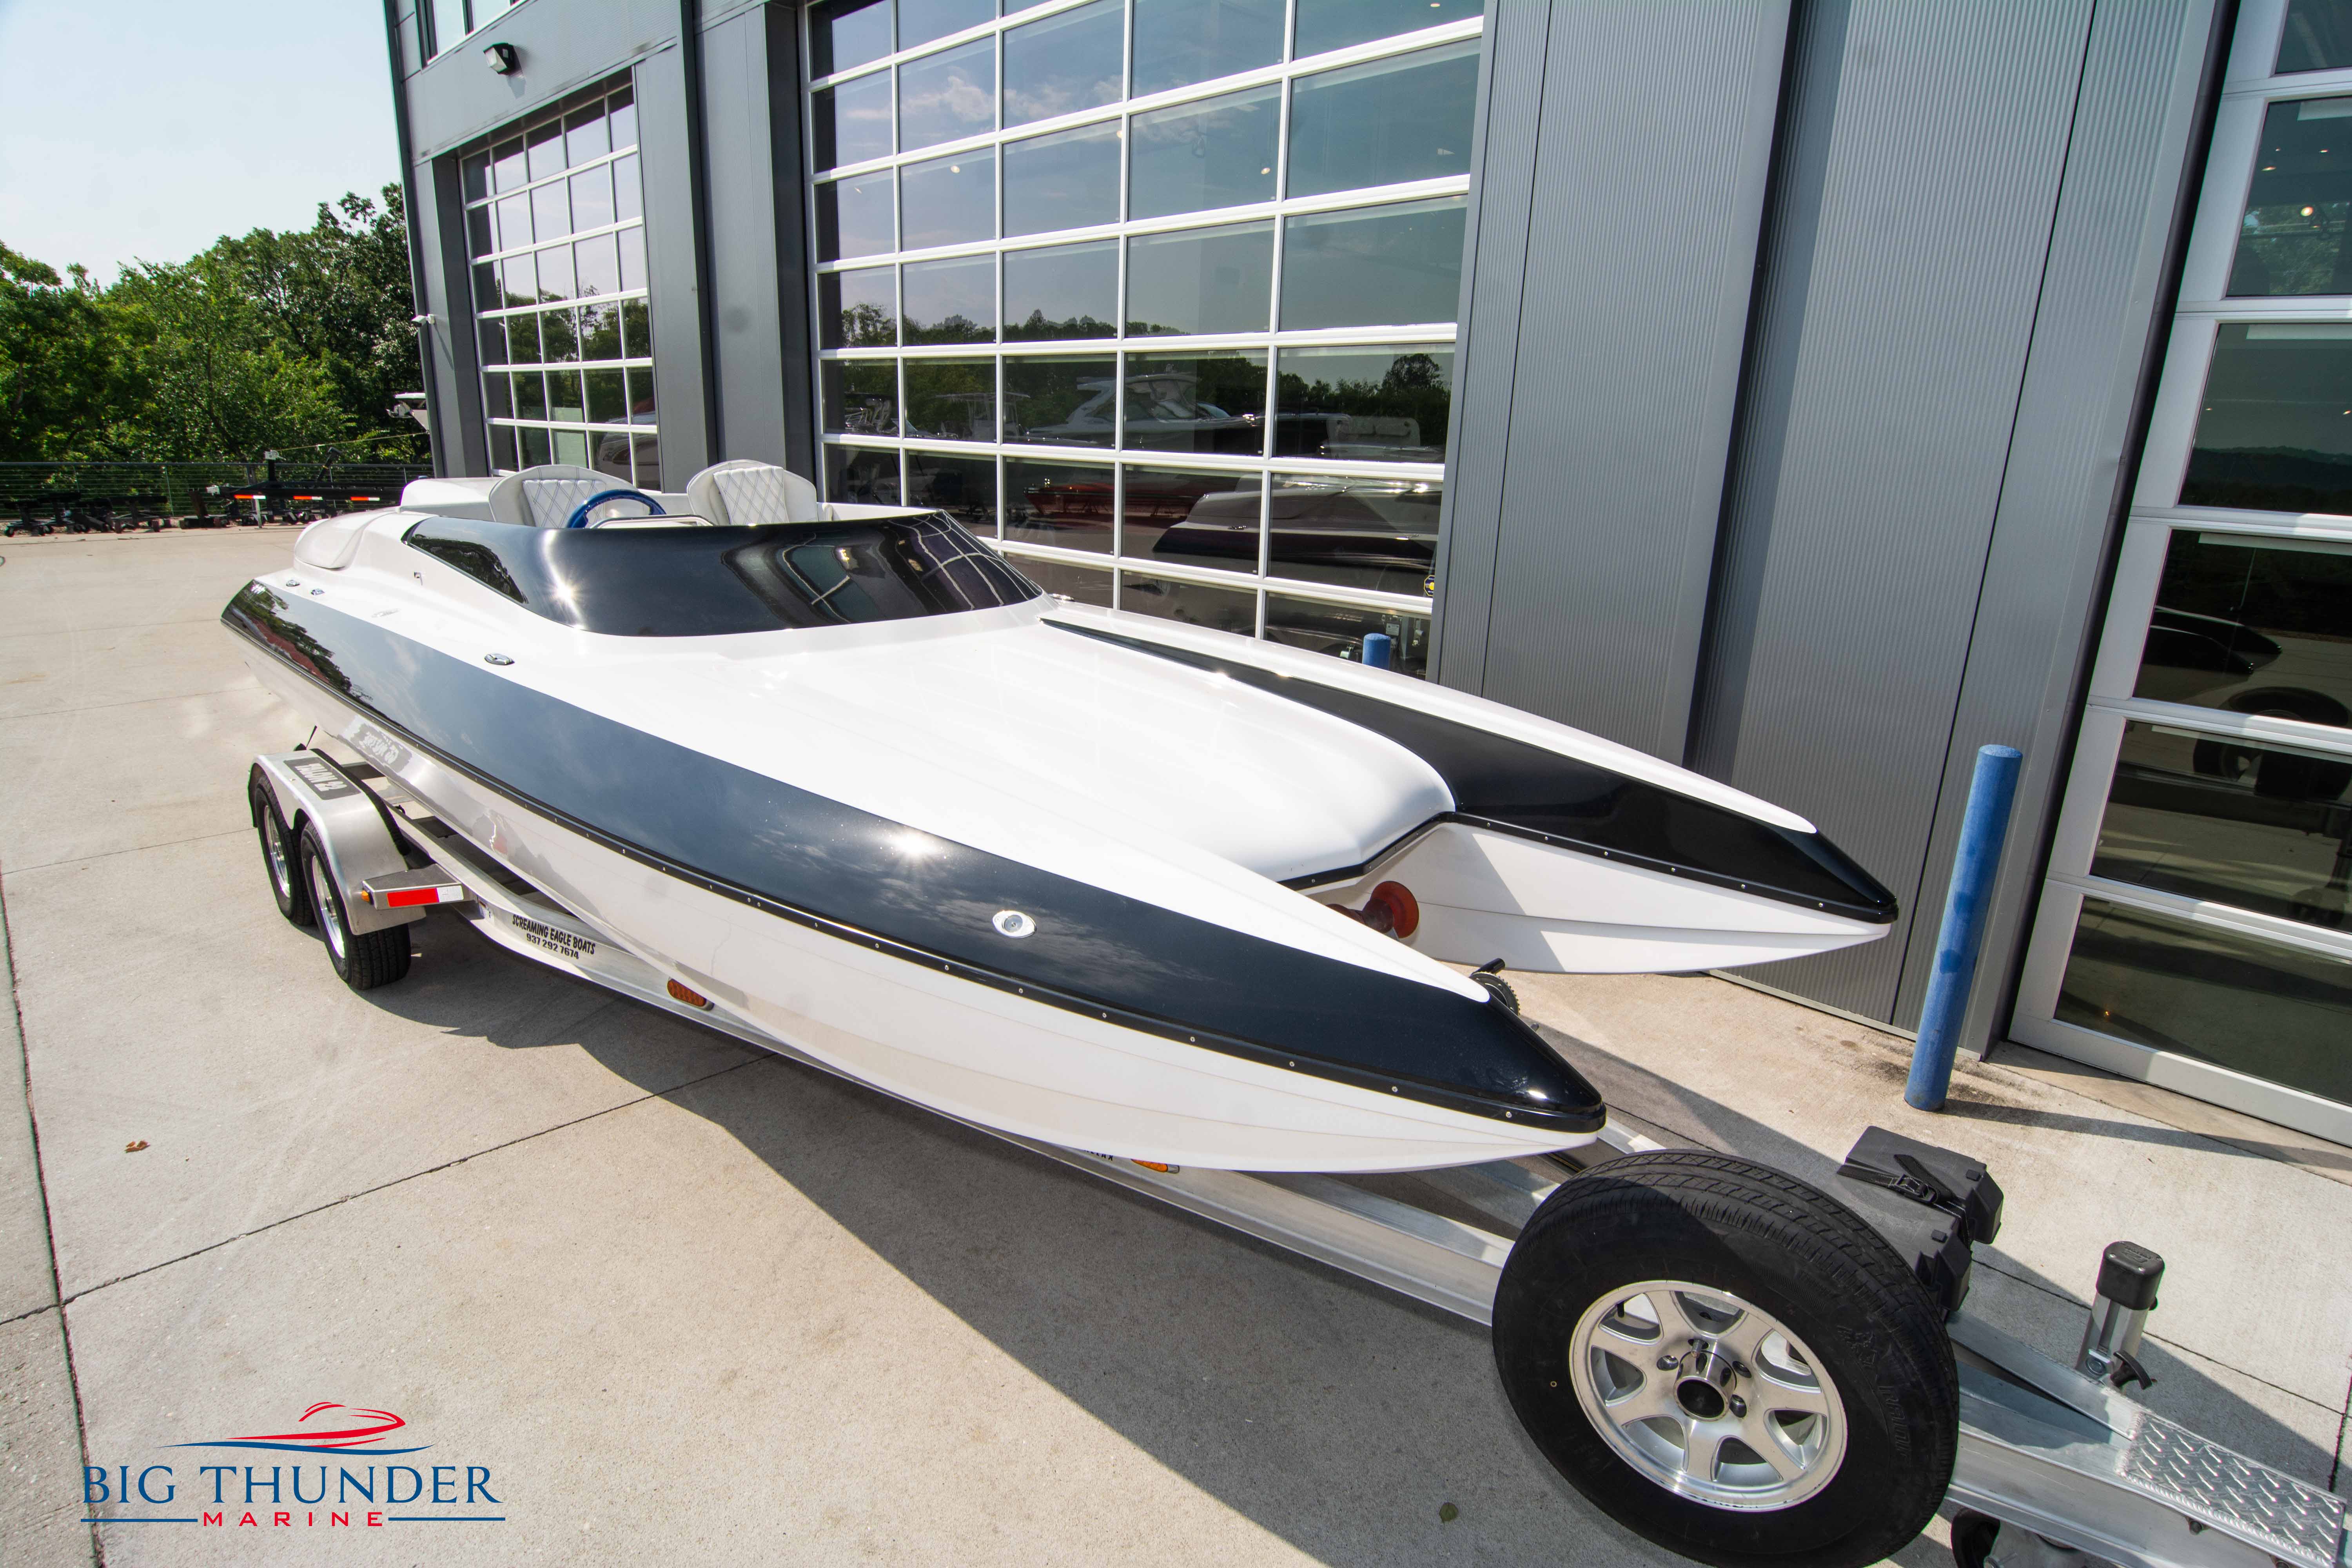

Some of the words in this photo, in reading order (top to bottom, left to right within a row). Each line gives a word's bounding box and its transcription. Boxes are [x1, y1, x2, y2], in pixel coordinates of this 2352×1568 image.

[294, 763, 338, 783] TALON
[314, 781, 347, 791] 22
[512, 914, 549, 938] SCREAMING
[550, 928, 572, 947] EAGLE
[573, 936, 596, 955] BOATS
[526, 933, 541, 946] 937
[542, 939, 558, 952] 292
[560, 945, 579, 960] 7674
